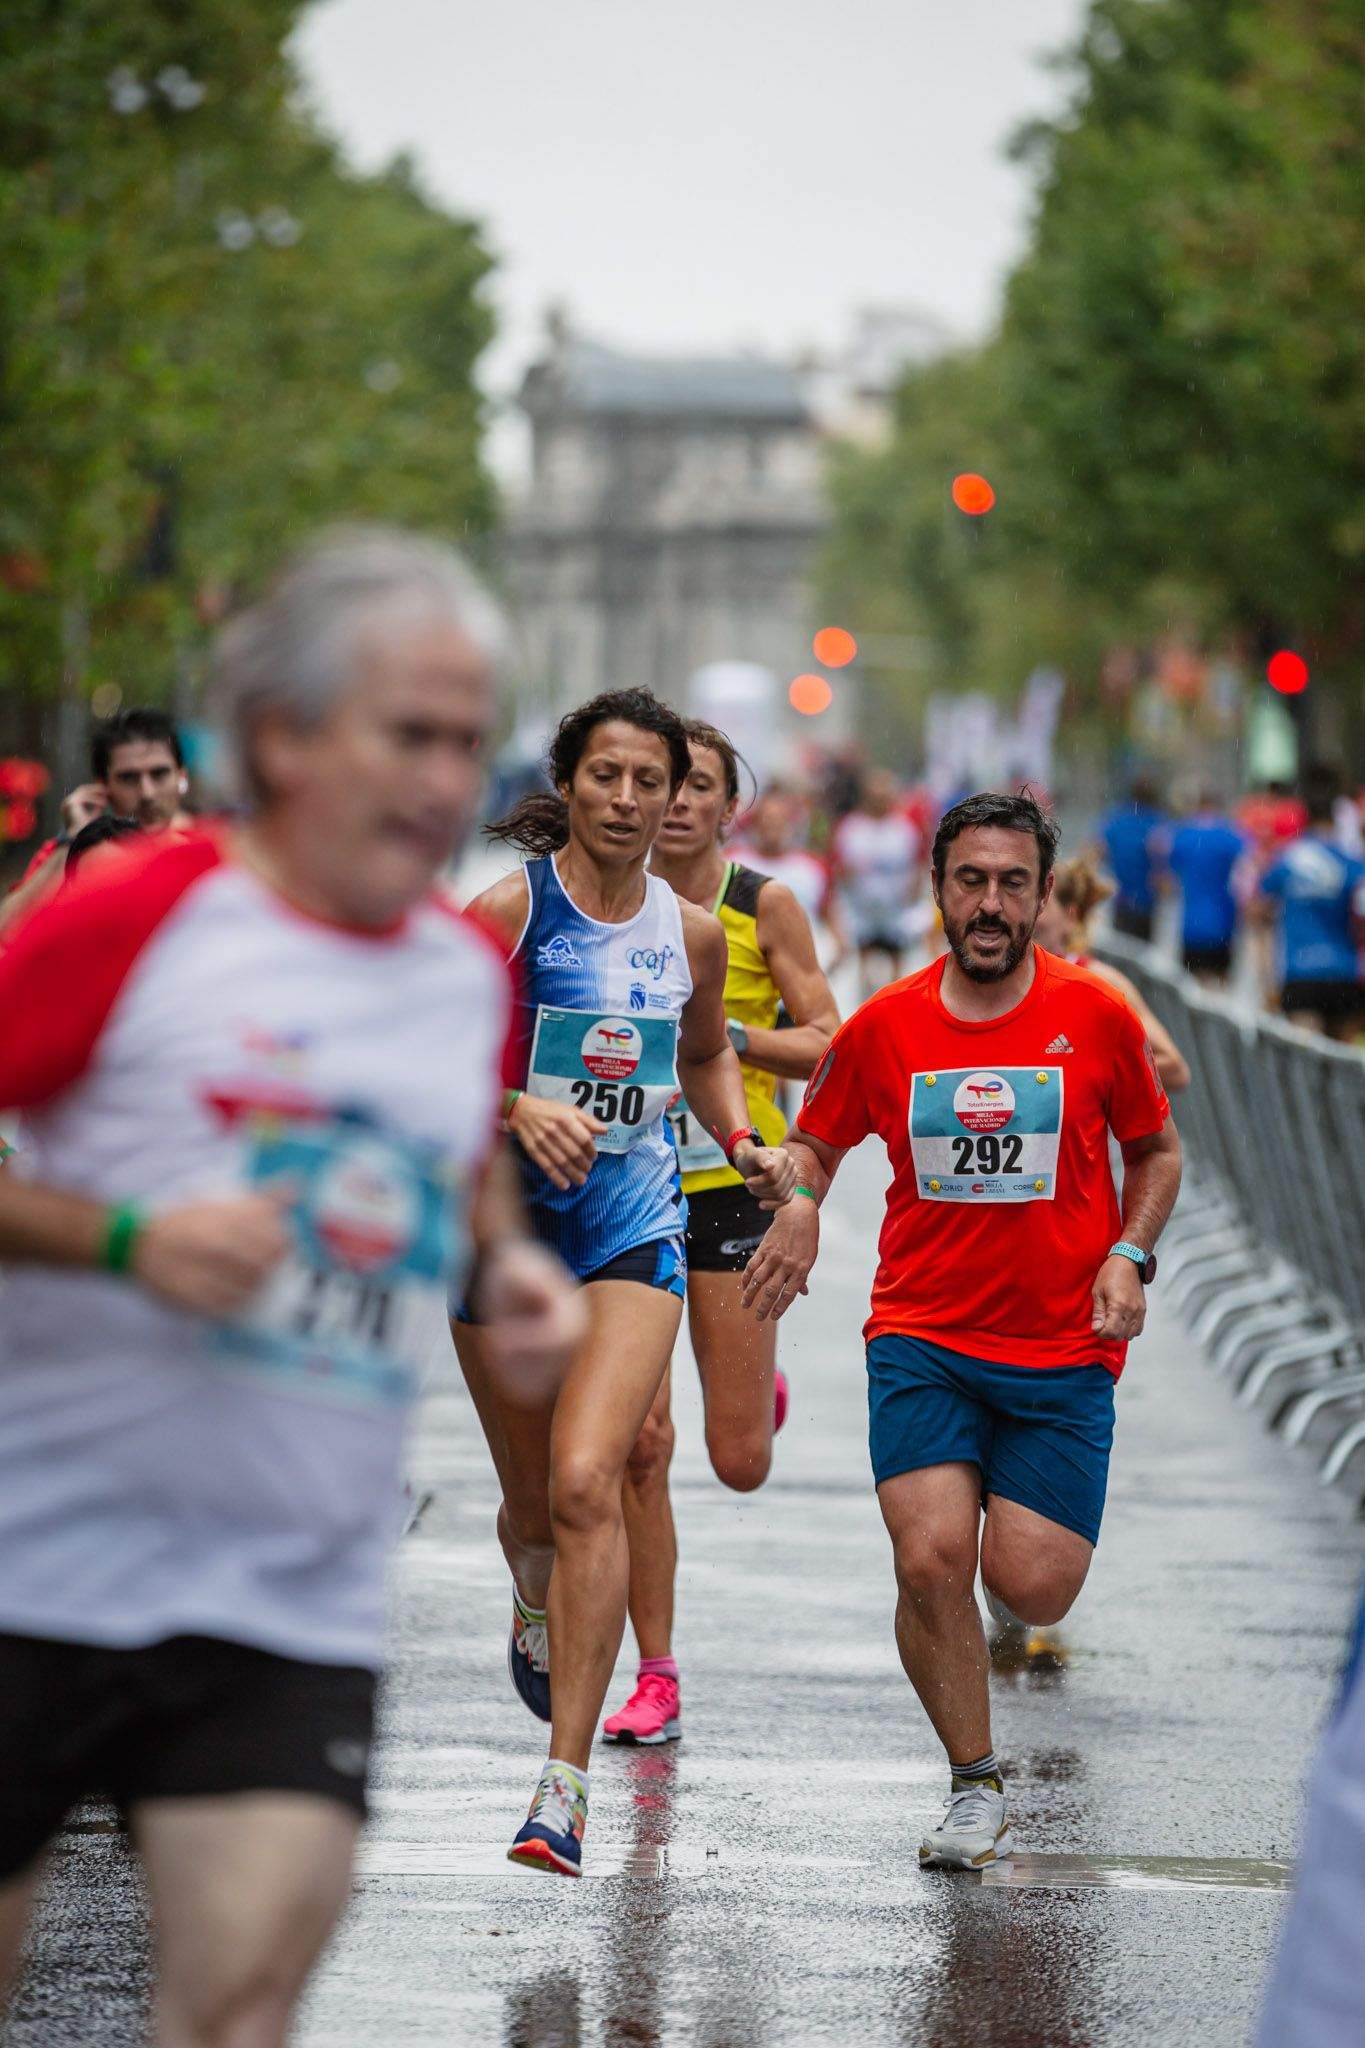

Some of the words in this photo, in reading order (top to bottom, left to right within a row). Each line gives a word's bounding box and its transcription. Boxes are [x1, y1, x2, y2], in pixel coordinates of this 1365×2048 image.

[538, 955, 583, 968] austral
[1045, 1046, 1074, 1054] adidas
[571, 1081, 644, 1126] 250
[952, 1135, 1023, 1175] 292
[939, 1184, 963, 1192] ADRID
